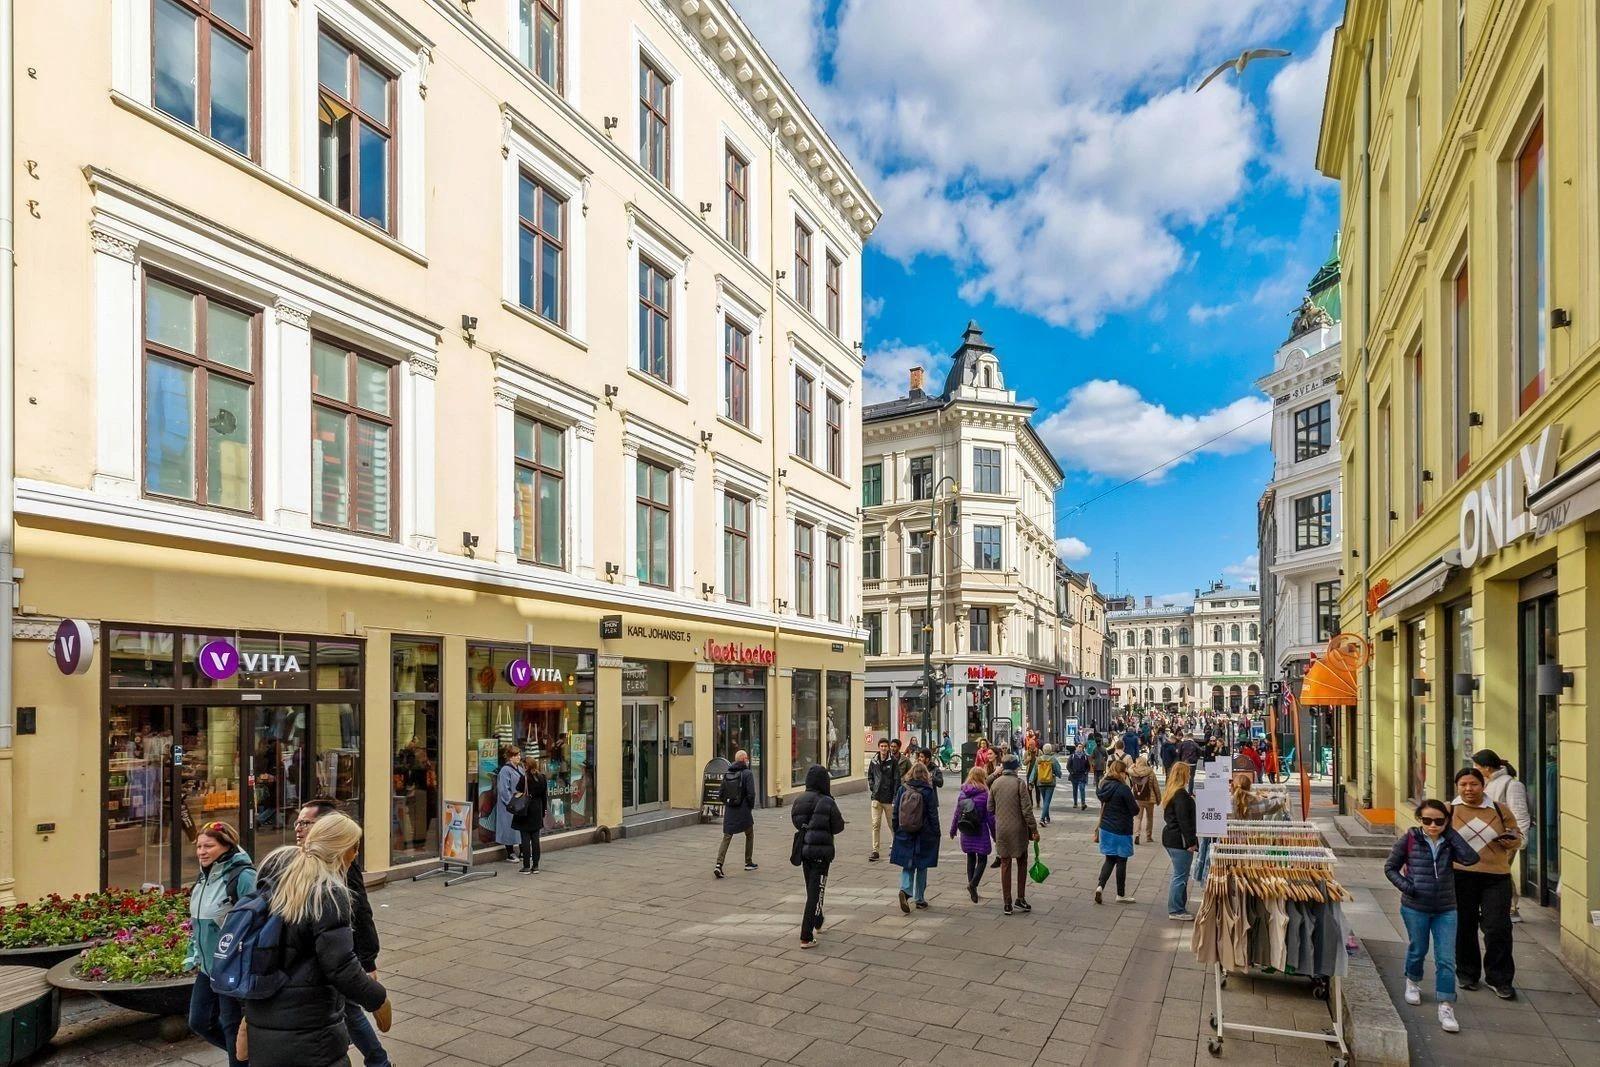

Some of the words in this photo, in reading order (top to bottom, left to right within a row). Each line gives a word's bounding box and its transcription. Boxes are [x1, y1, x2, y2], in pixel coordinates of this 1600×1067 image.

[1293, 382, 1317, 398] SVEA
[1460, 423, 1562, 569] ONLY
[1538, 501, 1571, 535] ONLY
[627, 625, 648, 638] KARL
[648, 628, 686, 642] JOHANSGT.
[686, 632, 691, 642] 5
[703, 638, 735, 662] Foot
[739, 642, 776, 665] Locker
[242, 652, 301, 673] VITA
[531, 667, 562, 682] VITA
[1271, 683, 1279, 692] P
[547, 785, 563, 797] Hele
[1201, 811, 1222, 821] 249.95
